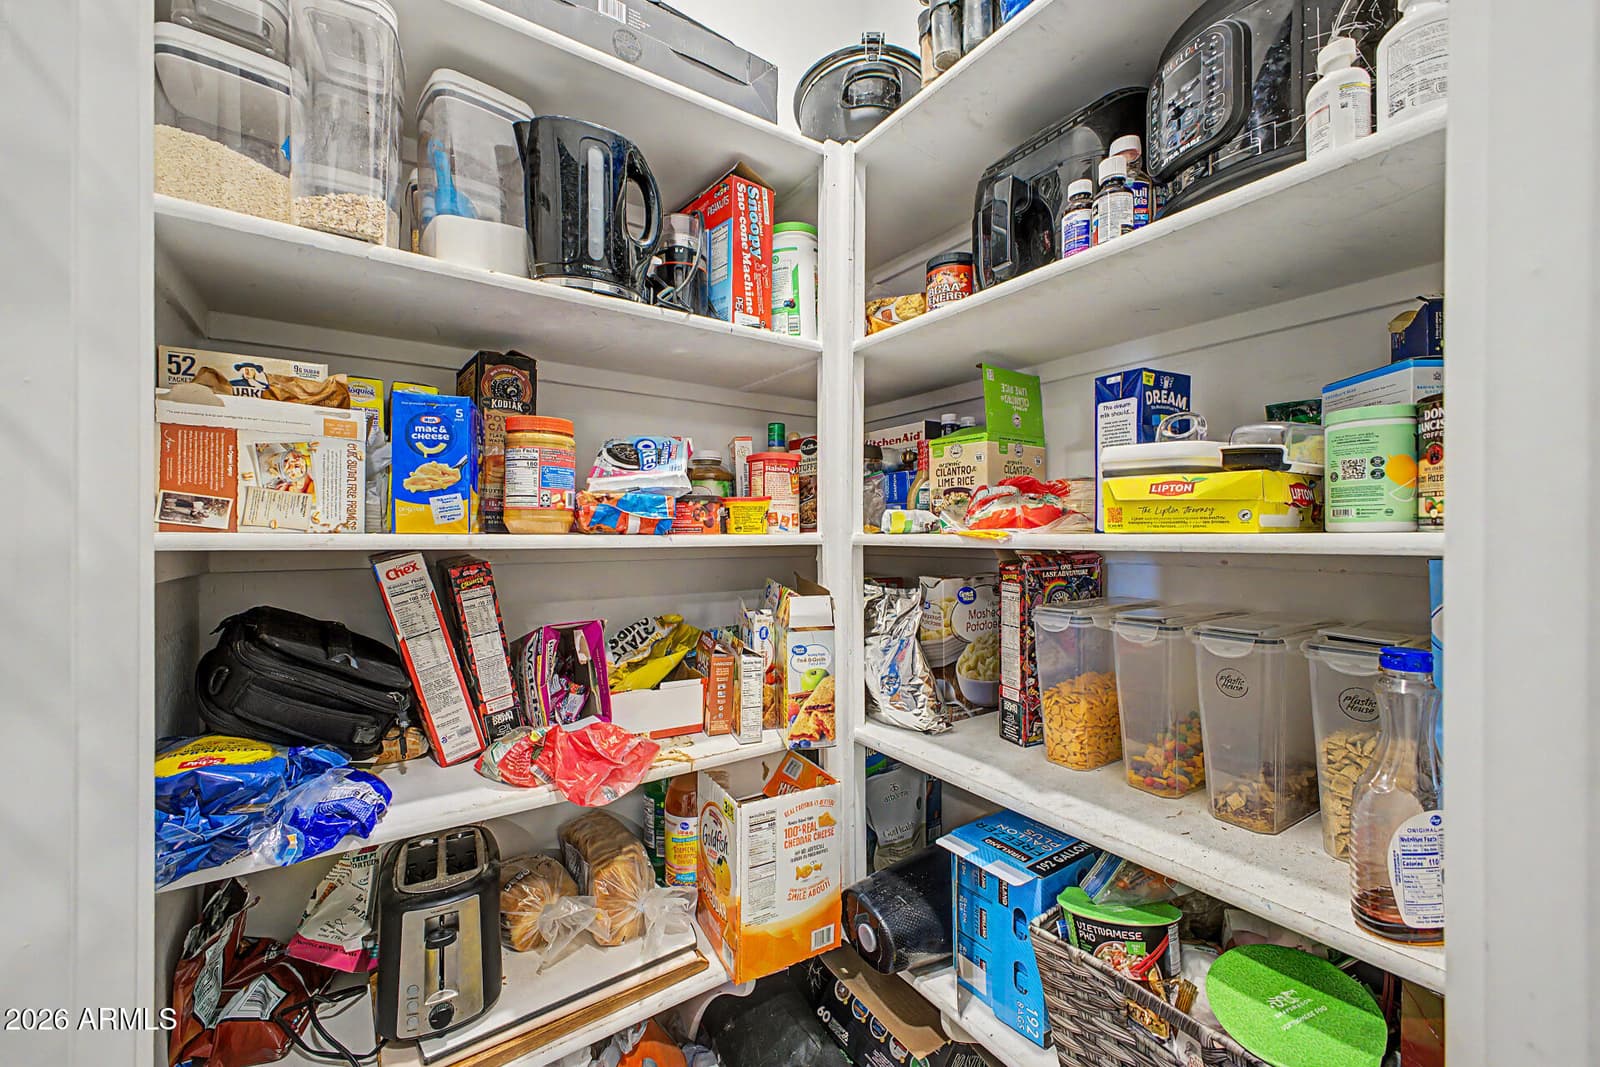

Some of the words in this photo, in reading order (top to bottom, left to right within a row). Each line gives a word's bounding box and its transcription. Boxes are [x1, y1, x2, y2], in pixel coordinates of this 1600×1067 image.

[707, 196, 730, 217] PEANUTS
[736, 182, 749, 250] Sno-cone
[748, 185, 762, 261] Snoopy
[741, 251, 754, 316] Machine
[167, 354, 196, 377] 52
[455, 408, 463, 418] 5
[491, 398, 524, 412] KODIAK
[415, 425, 438, 433] mac
[635, 439, 657, 471] OREO
[936, 465, 971, 477] CILANTRO
[1004, 464, 1029, 475] CILANTRO
[937, 478, 955, 487] LIME
[957, 476, 975, 485] RICE
[1151, 484, 1193, 493] LIPTON
[1291, 487, 1313, 501] LIPTON
[1154, 506, 1179, 516] Lipton
[385, 562, 421, 581] Chex
[966, 621, 998, 632] Potatoe
[1222, 682, 1243, 692] House
[1346, 702, 1375, 715] House
[801, 821, 818, 834] REAL
[702, 824, 728, 856] Goldfish
[784, 835, 812, 849] CHEDDAR
[813, 827, 835, 840] CHEESE
[976, 821, 1046, 856] FREEZER
[996, 823, 1053, 851] GALLON
[984, 839, 1028, 862] KIRKLAND
[1036, 860, 1057, 872] 192
[1053, 842, 1092, 864] GALLON
[787, 891, 807, 901] SMILE
[1077, 921, 1143, 940] VIETNAMESE
[1079, 931, 1096, 942] PHO
[817, 1006, 831, 1022] 60
[1026, 1008, 1039, 1039] 192
